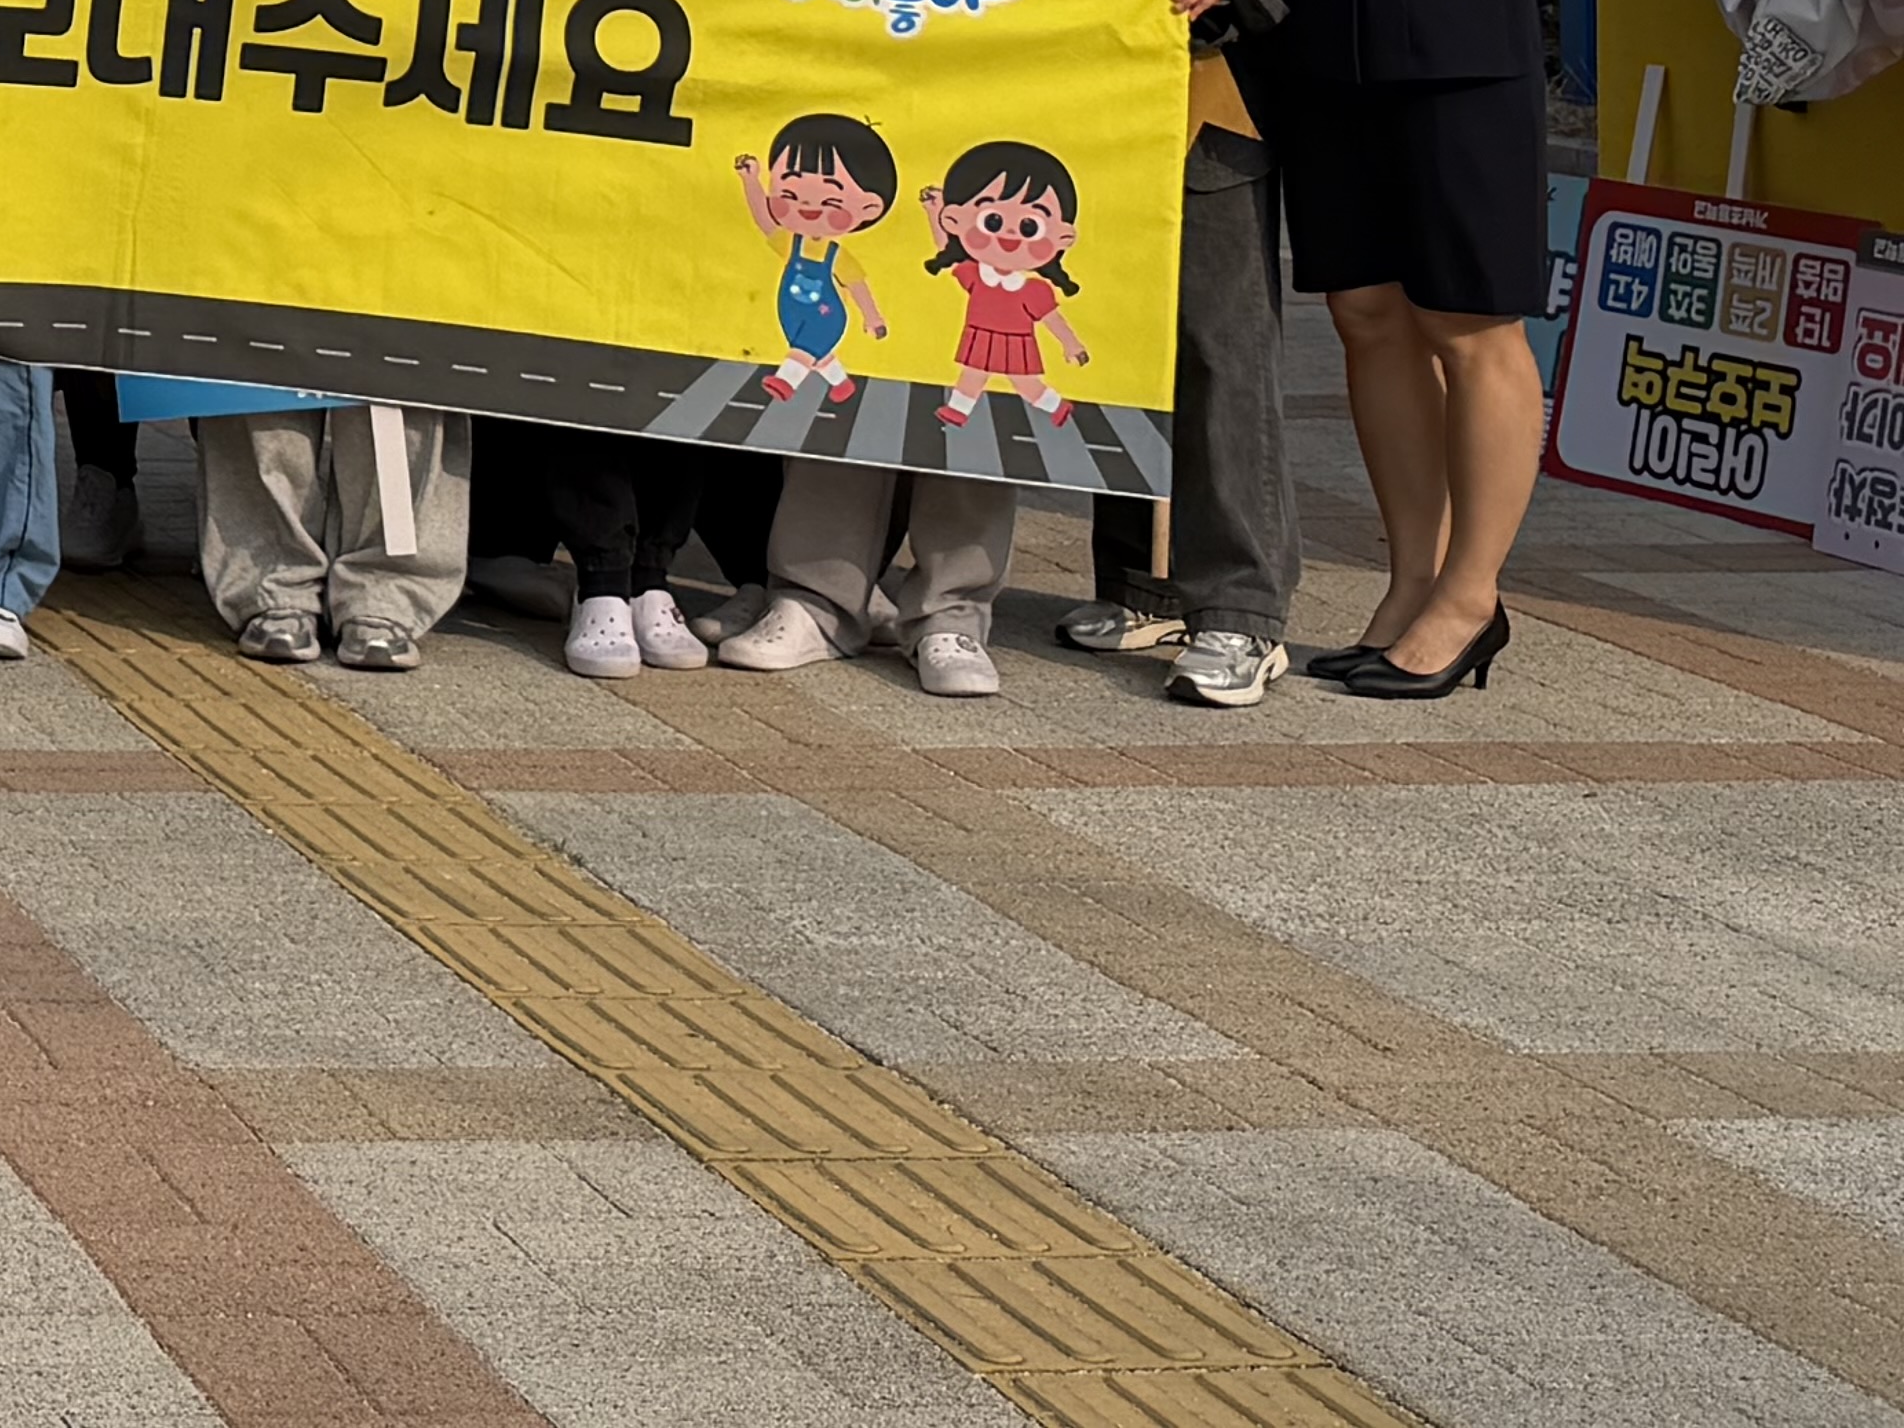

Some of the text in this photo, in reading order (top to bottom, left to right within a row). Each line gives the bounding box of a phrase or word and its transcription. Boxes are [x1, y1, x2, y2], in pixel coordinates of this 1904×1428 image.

[1622, 341, 1798, 433] 보호구역
[1632, 408, 1769, 496] 어린이
[1833, 464, 1904, 532] 정차
